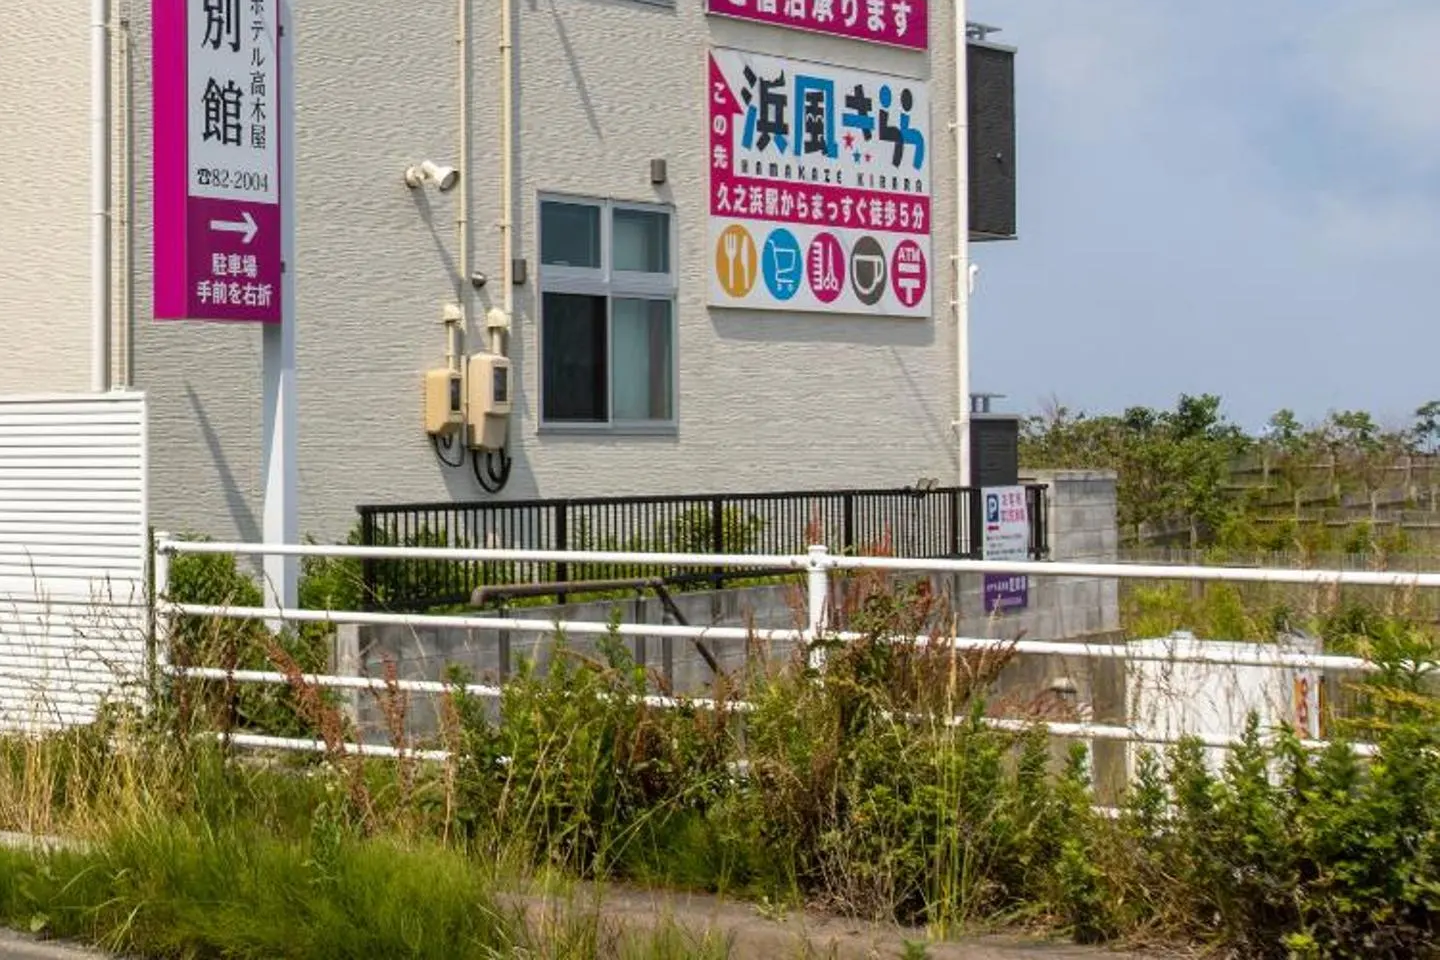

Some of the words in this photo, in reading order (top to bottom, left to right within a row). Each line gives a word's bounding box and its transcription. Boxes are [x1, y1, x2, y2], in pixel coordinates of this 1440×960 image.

[713, 82, 728, 170] この先
[211, 252, 258, 279] 駐車場
[898, 246, 921, 262] ATM
[196, 280, 273, 308] 手前を右折
